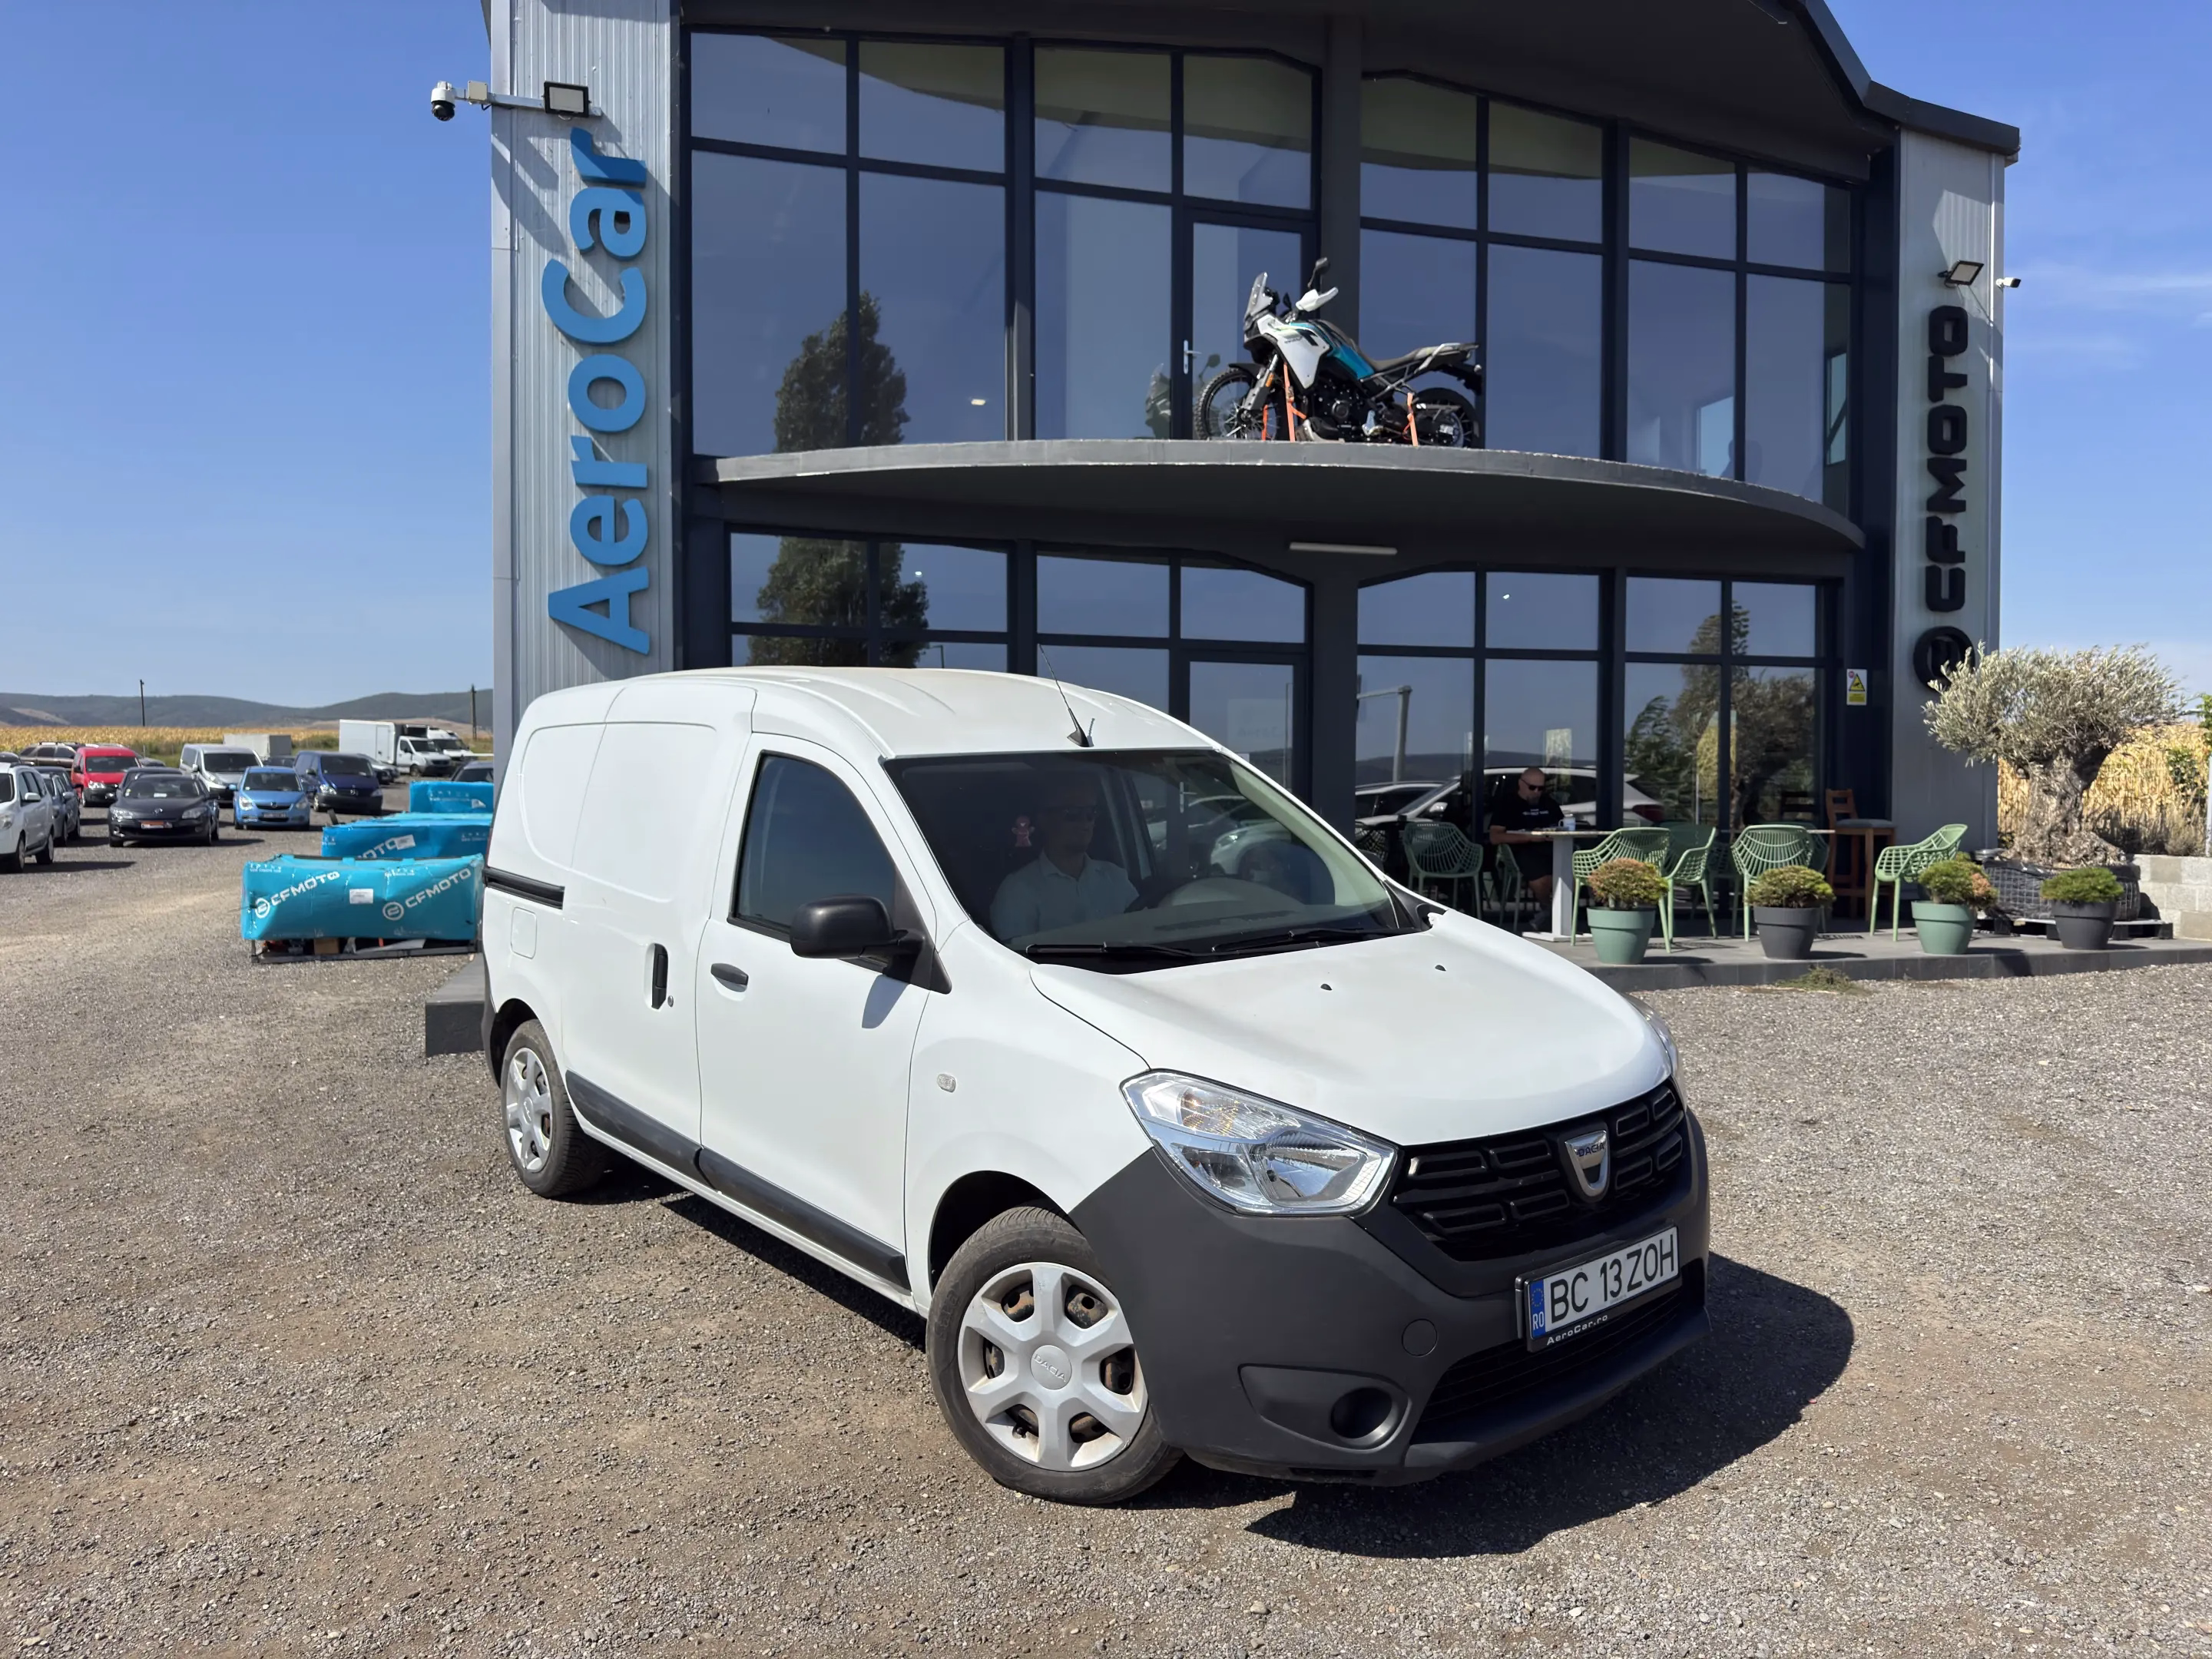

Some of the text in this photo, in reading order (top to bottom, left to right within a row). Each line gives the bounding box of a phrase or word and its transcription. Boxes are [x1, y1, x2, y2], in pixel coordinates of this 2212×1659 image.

[541, 127, 650, 655] AeroCar
[1925, 305, 1968, 613] CFMOTO
[270, 871, 340, 906] CFMOTO
[405, 867, 472, 909] CFMOTO
[1577, 1142, 1604, 1157] DACIA
[1550, 1272, 1588, 1324] BC
[1532, 1310, 1545, 1331] RO
[1546, 1315, 1608, 1346] AeroCar.ro
